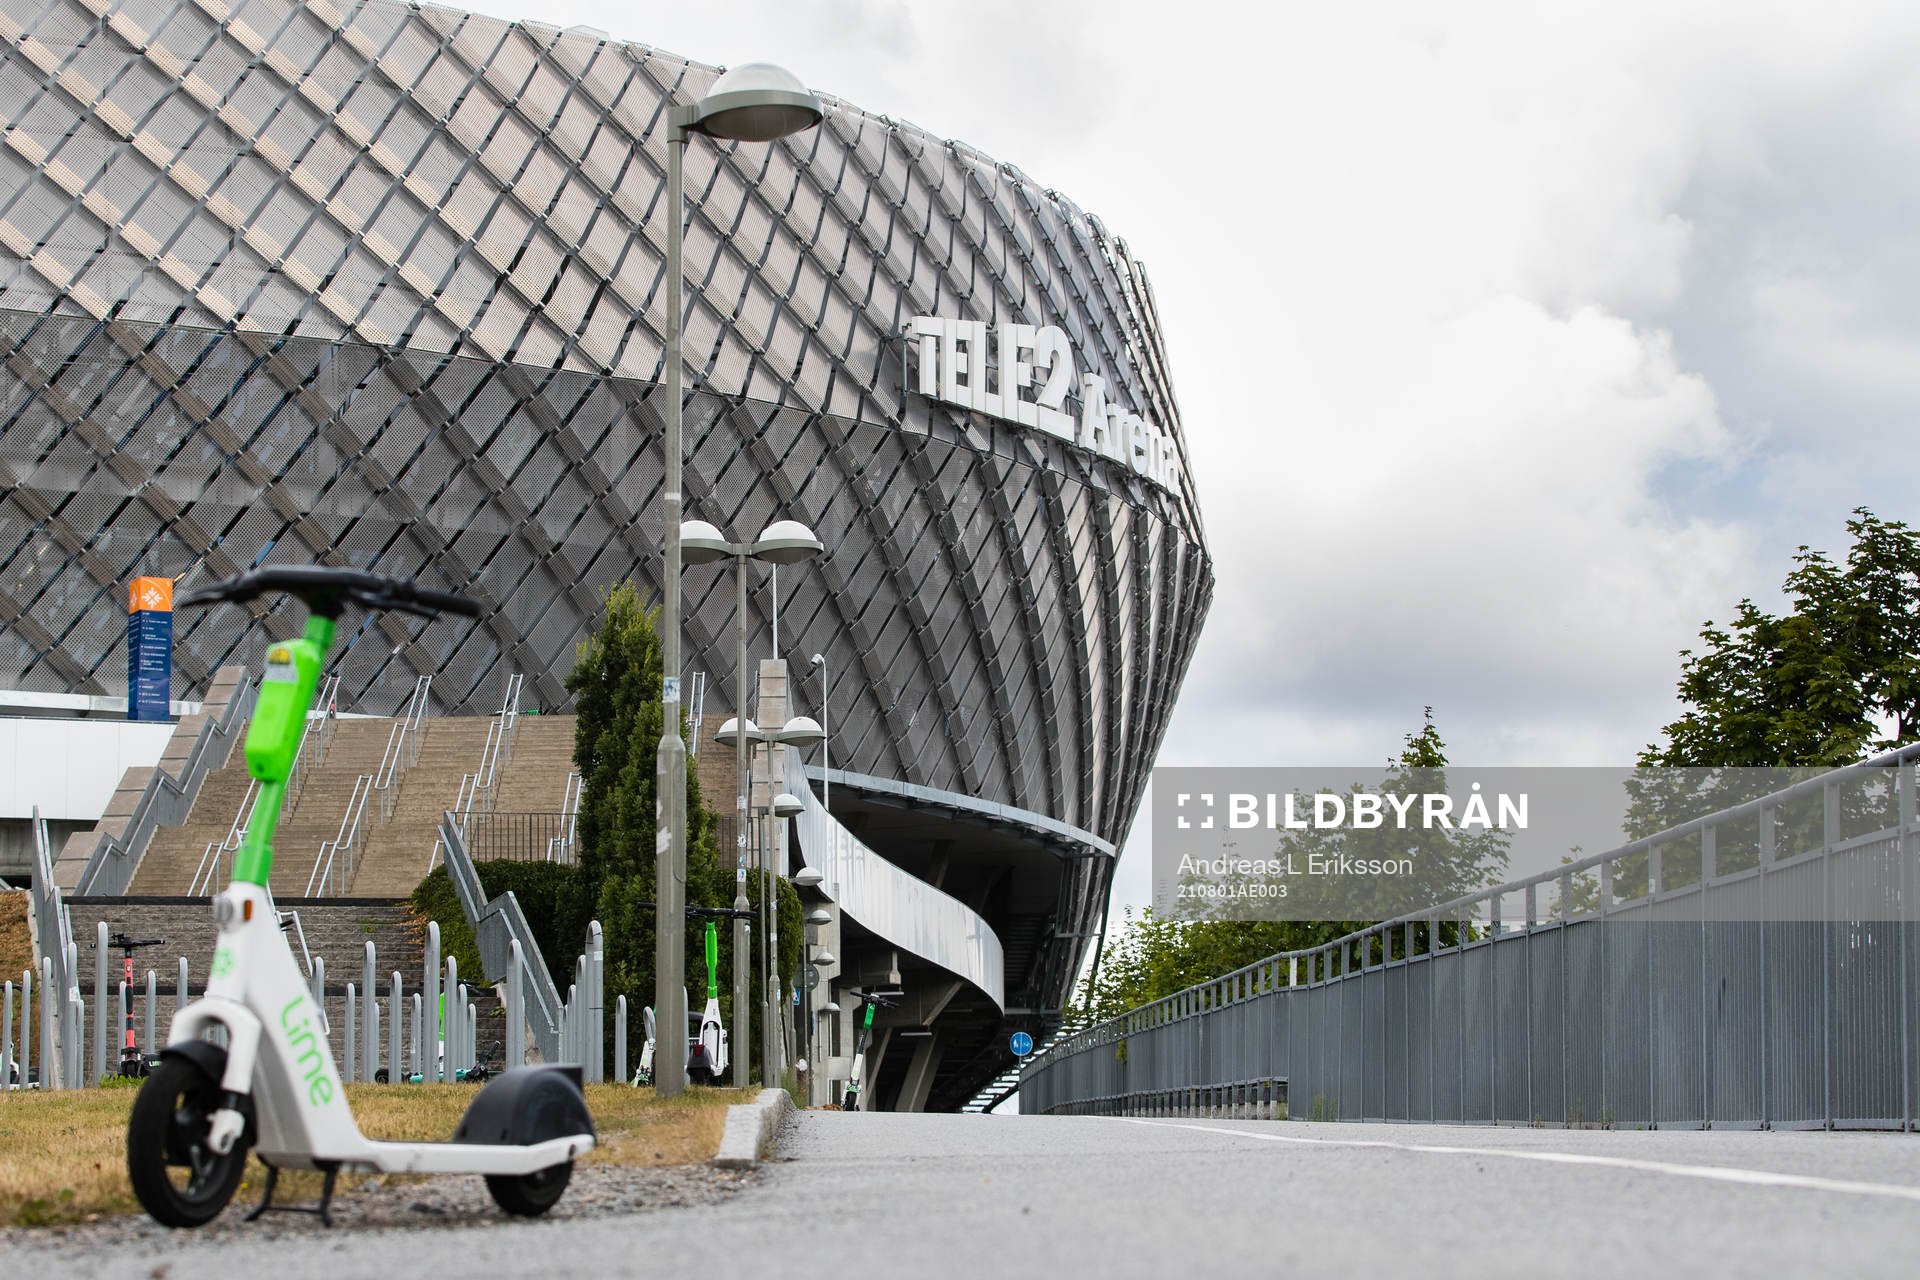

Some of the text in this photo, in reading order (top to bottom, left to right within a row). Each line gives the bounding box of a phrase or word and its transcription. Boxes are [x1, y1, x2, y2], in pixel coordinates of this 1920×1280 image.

[912, 316, 1182, 499] TELE2 Arena
[280, 995, 334, 1107] Lime
